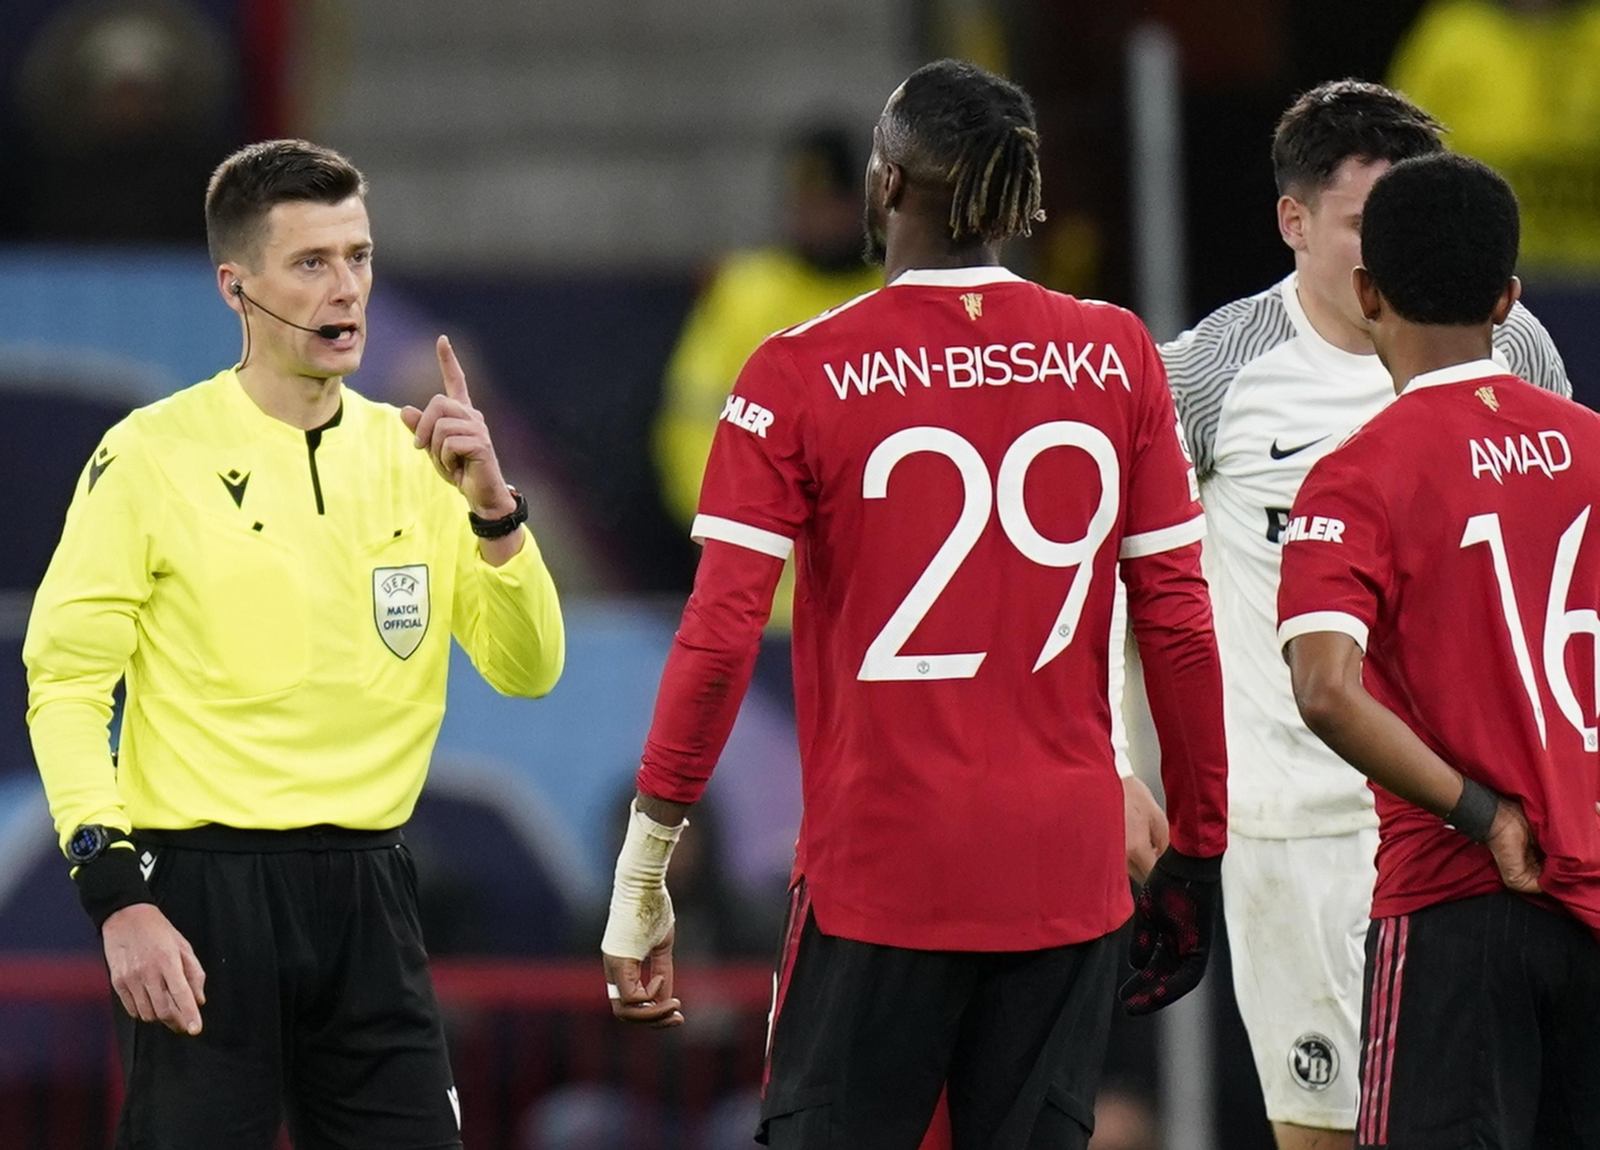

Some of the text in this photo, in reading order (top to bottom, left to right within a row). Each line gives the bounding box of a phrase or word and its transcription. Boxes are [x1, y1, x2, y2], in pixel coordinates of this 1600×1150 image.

[823, 341, 1132, 400] WAN-BISSAKA
[1469, 430, 1572, 485] AMAD
[857, 420, 1120, 681] 29
[1284, 516, 1346, 545] HLER
[383, 577, 416, 595] UEFA
[383, 618, 422, 630] OFFICIAL
[387, 604, 418, 616] MATCH
[1459, 504, 1600, 752] 16
